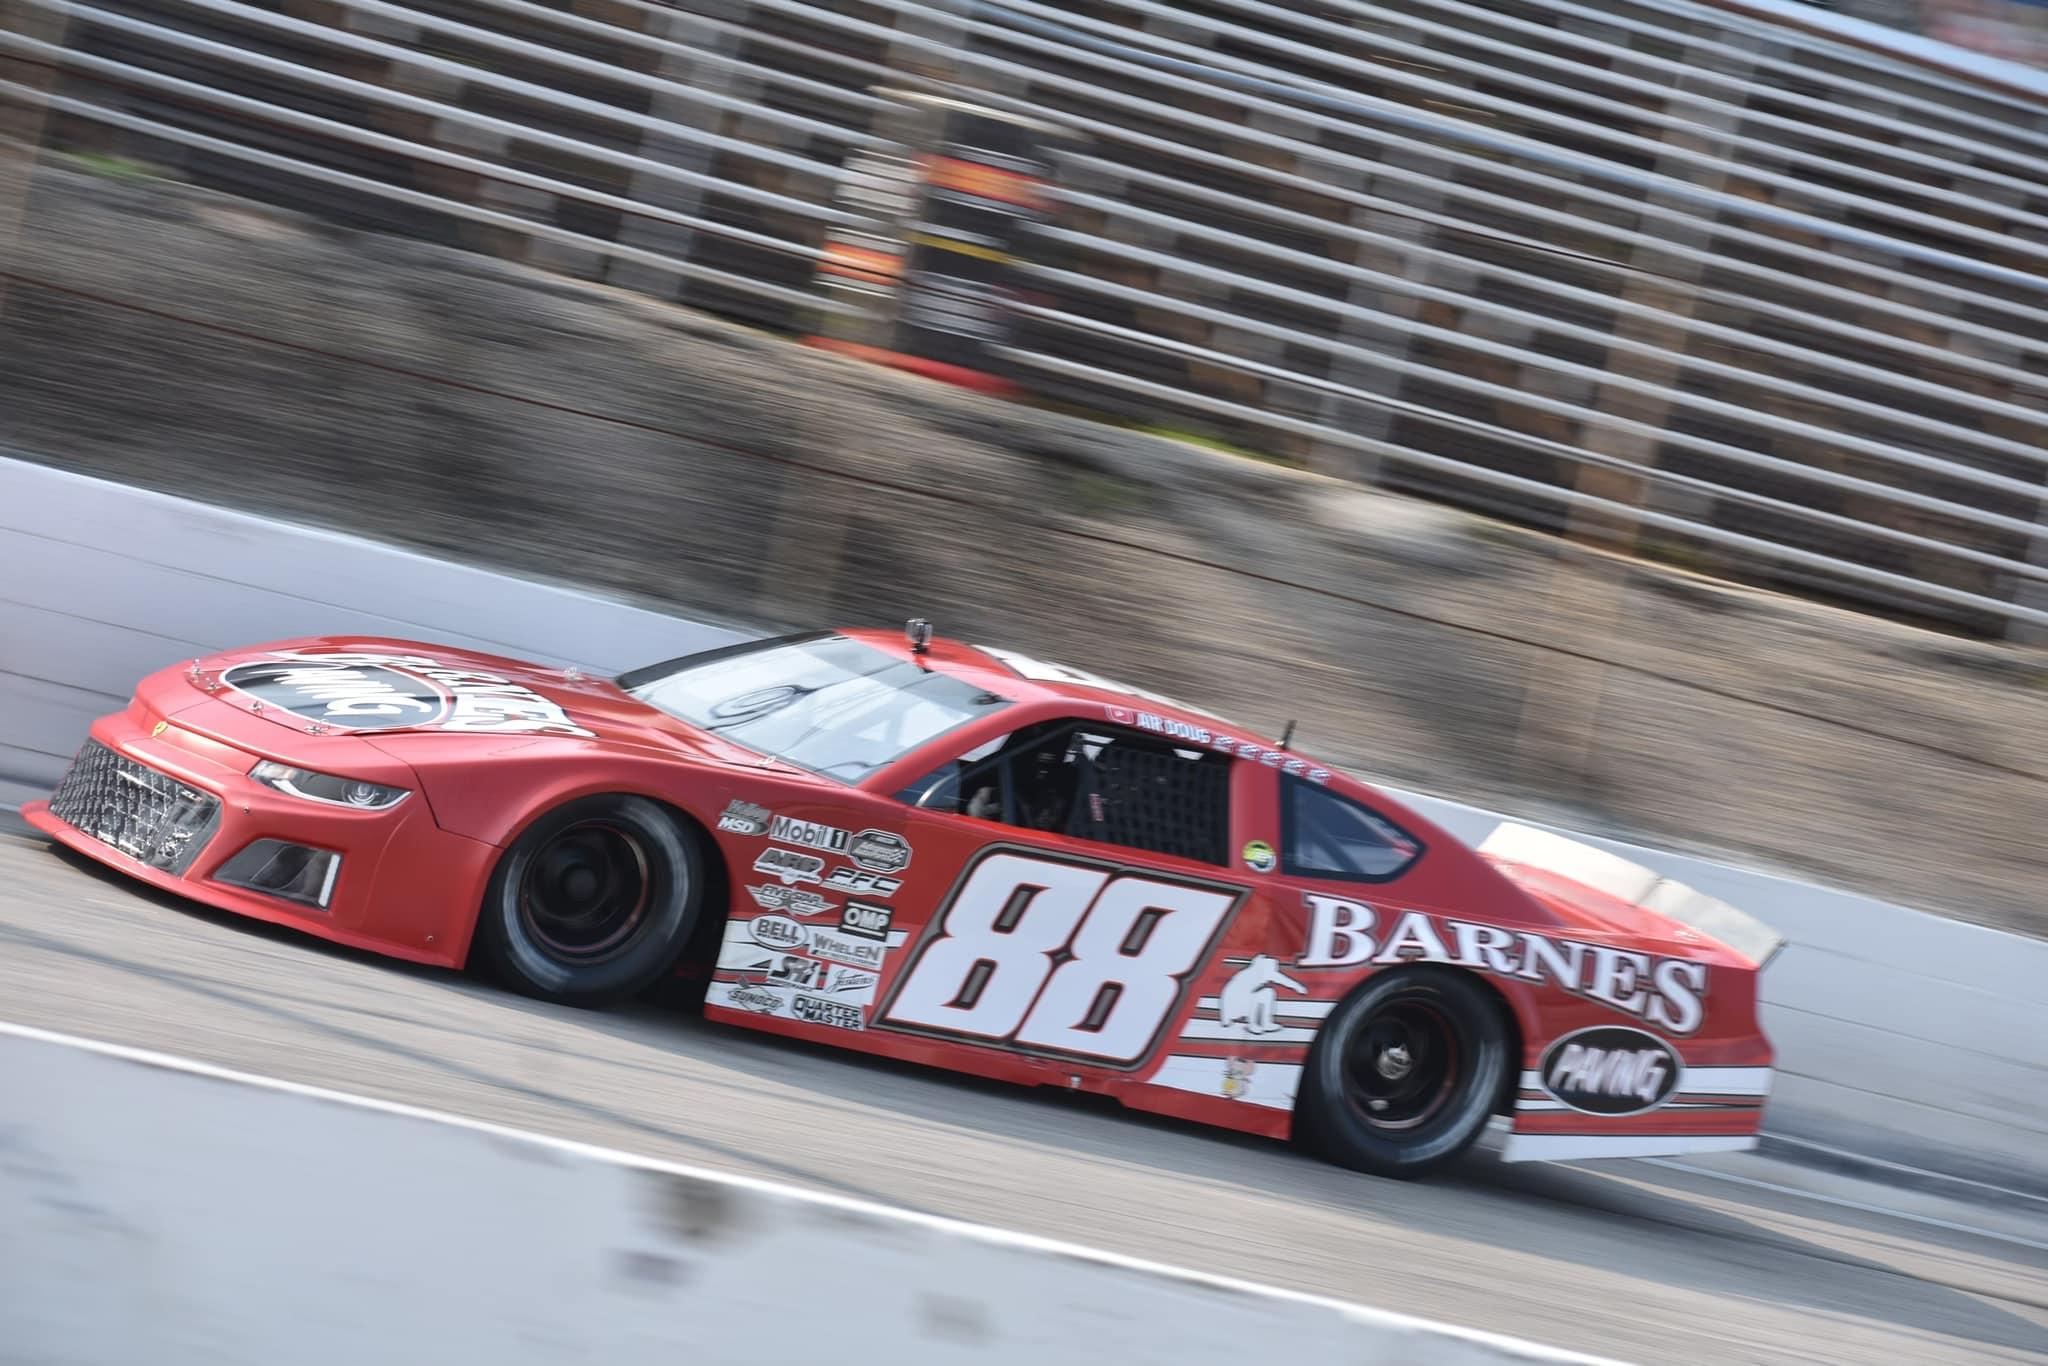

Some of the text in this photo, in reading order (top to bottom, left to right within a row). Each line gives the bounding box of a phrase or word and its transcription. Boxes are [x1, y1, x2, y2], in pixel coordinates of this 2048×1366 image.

[717, 816, 755, 833] MSD
[771, 816, 846, 850] Mobil 1
[763, 885, 789, 900] FIVE
[756, 918, 799, 940] BELL
[844, 907, 889, 931] OMP
[813, 932, 881, 959] WHELEN
[884, 853, 1238, 1062] 88
[1308, 893, 1706, 1036] BARNES
[731, 990, 780, 1010] SUNOCO
[792, 997, 860, 1017] QUARTER
[803, 1010, 859, 1030] MASTER
[1549, 1043, 1668, 1103] PAVING
